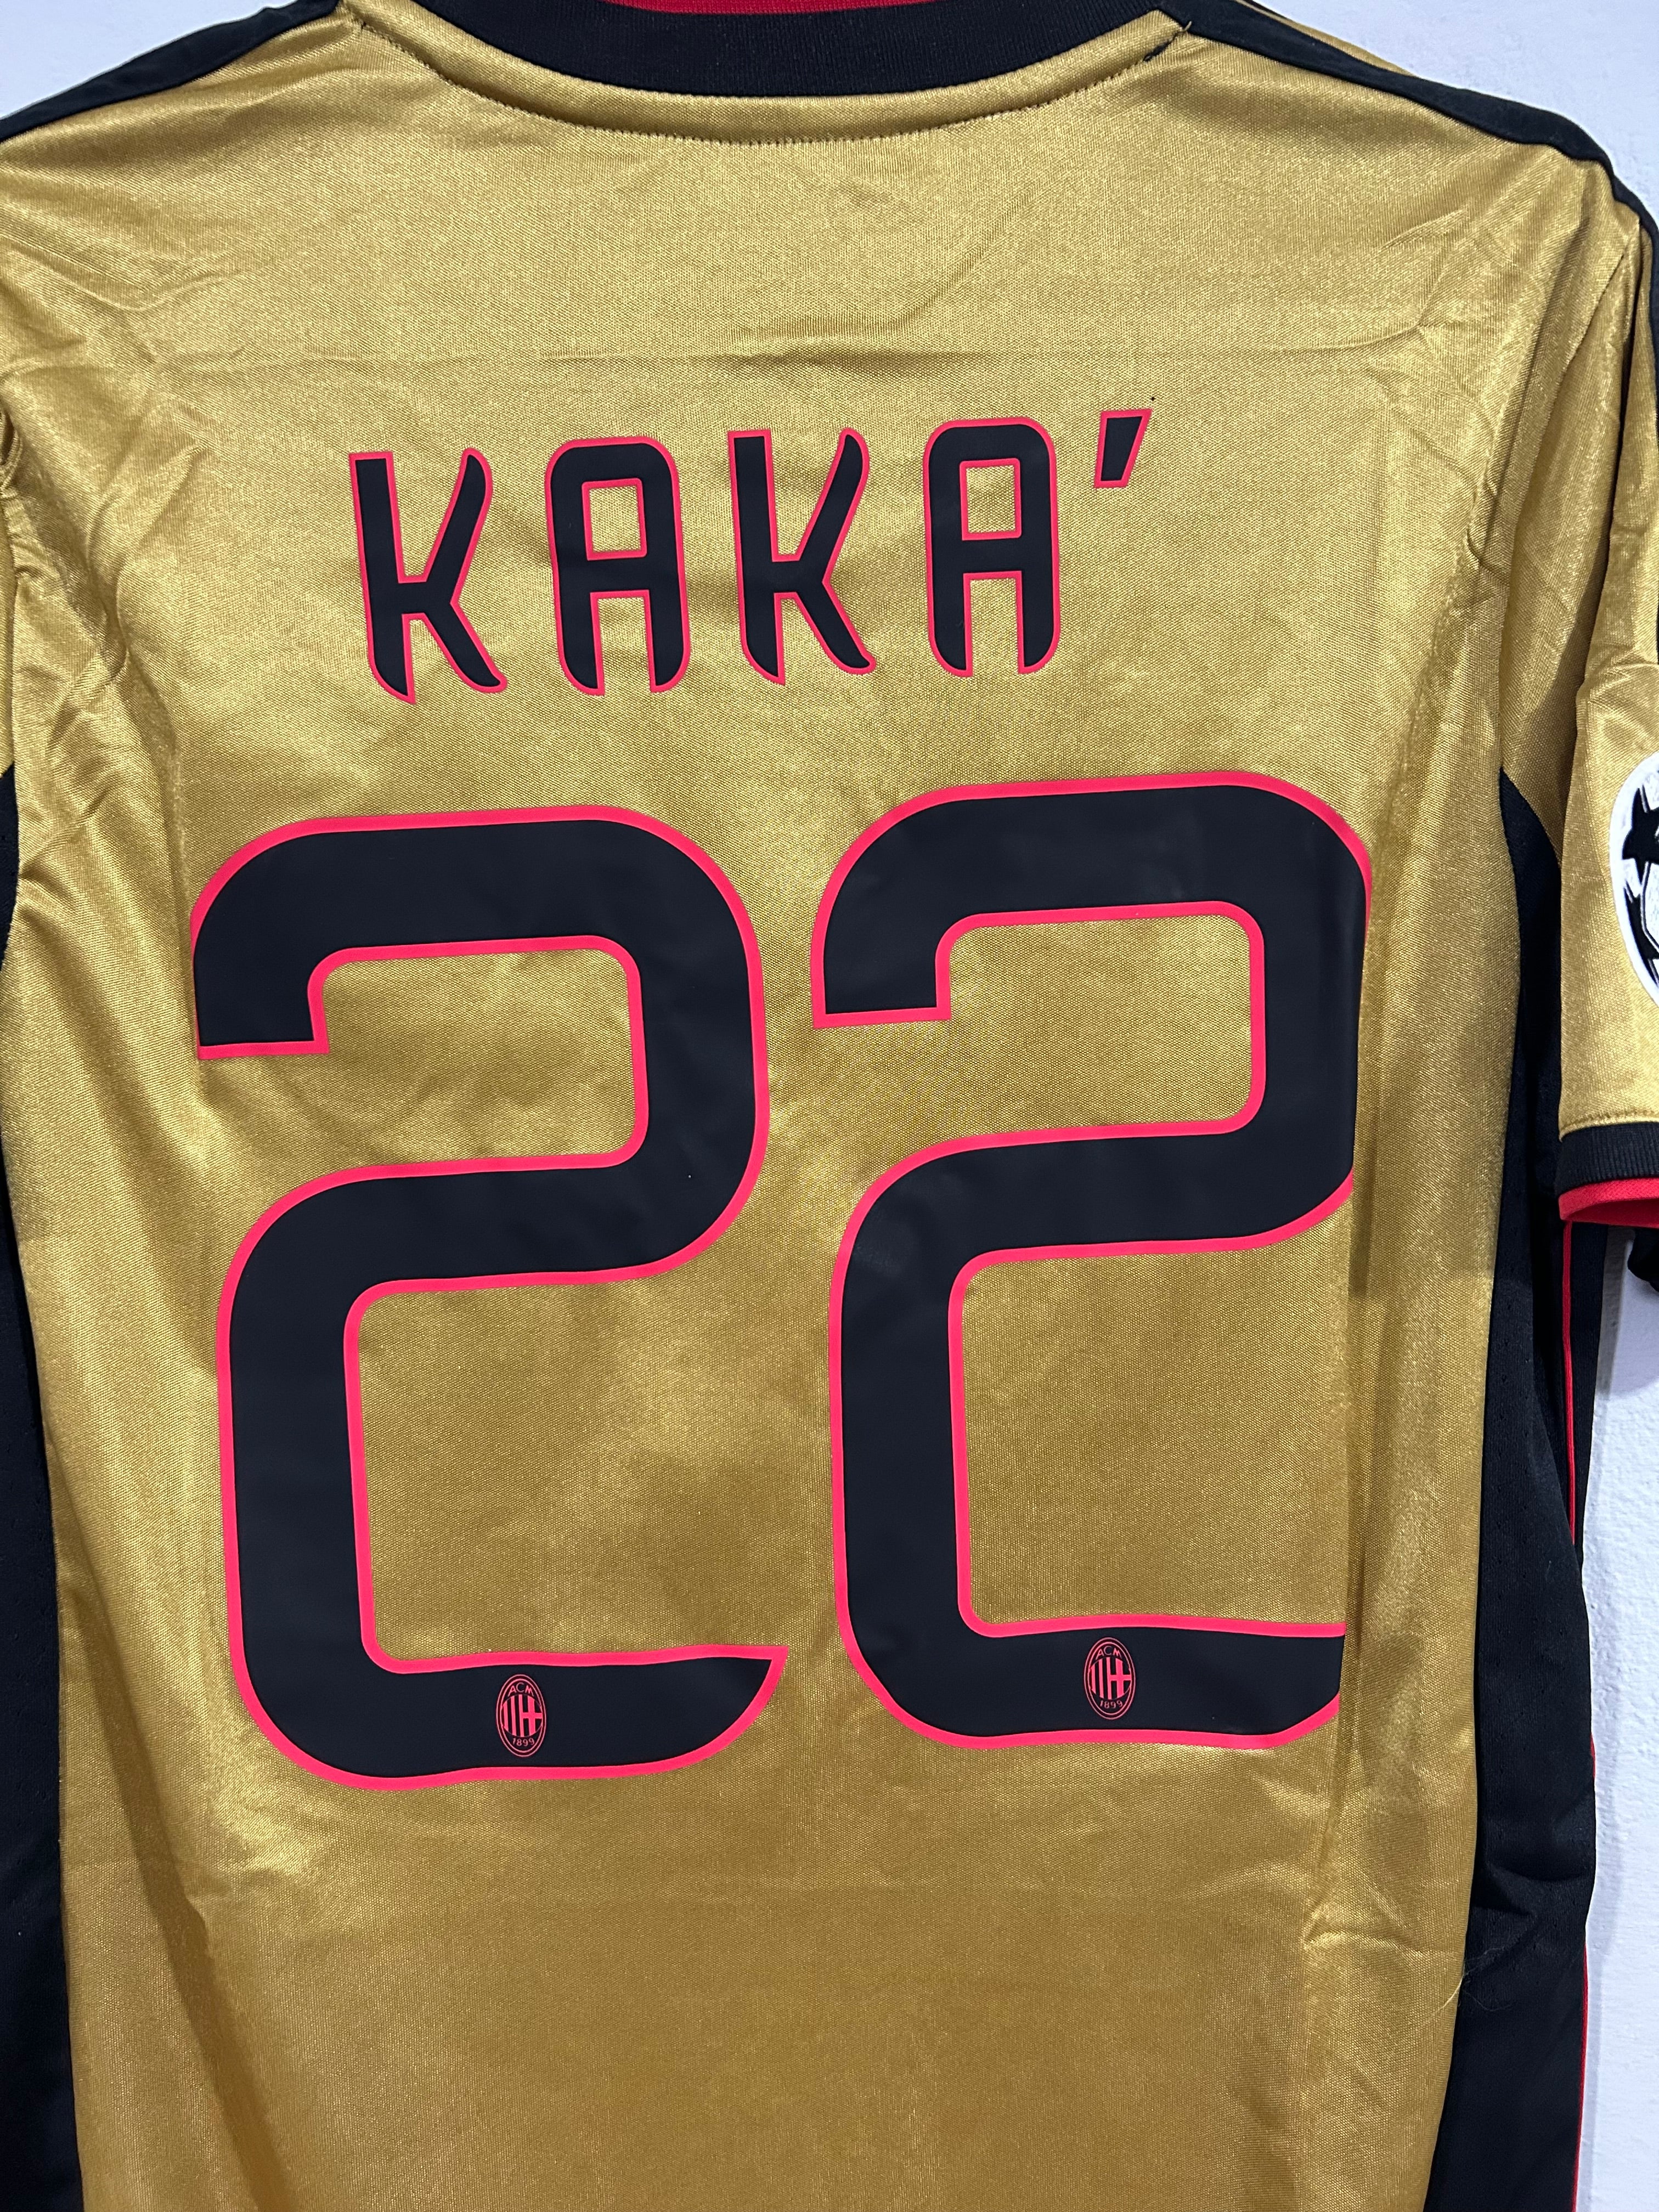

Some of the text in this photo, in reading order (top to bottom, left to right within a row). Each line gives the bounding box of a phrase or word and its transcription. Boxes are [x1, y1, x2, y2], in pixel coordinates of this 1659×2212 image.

[349, 409, 1153, 702] KAKA'
[190, 771, 1372, 1789] 22
[1096, 1646, 1121, 1660] ACM
[508, 1683, 534, 1697] ACM
[1100, 1700, 1122, 1708] 1899
[512, 1738, 534, 1746] 1899
